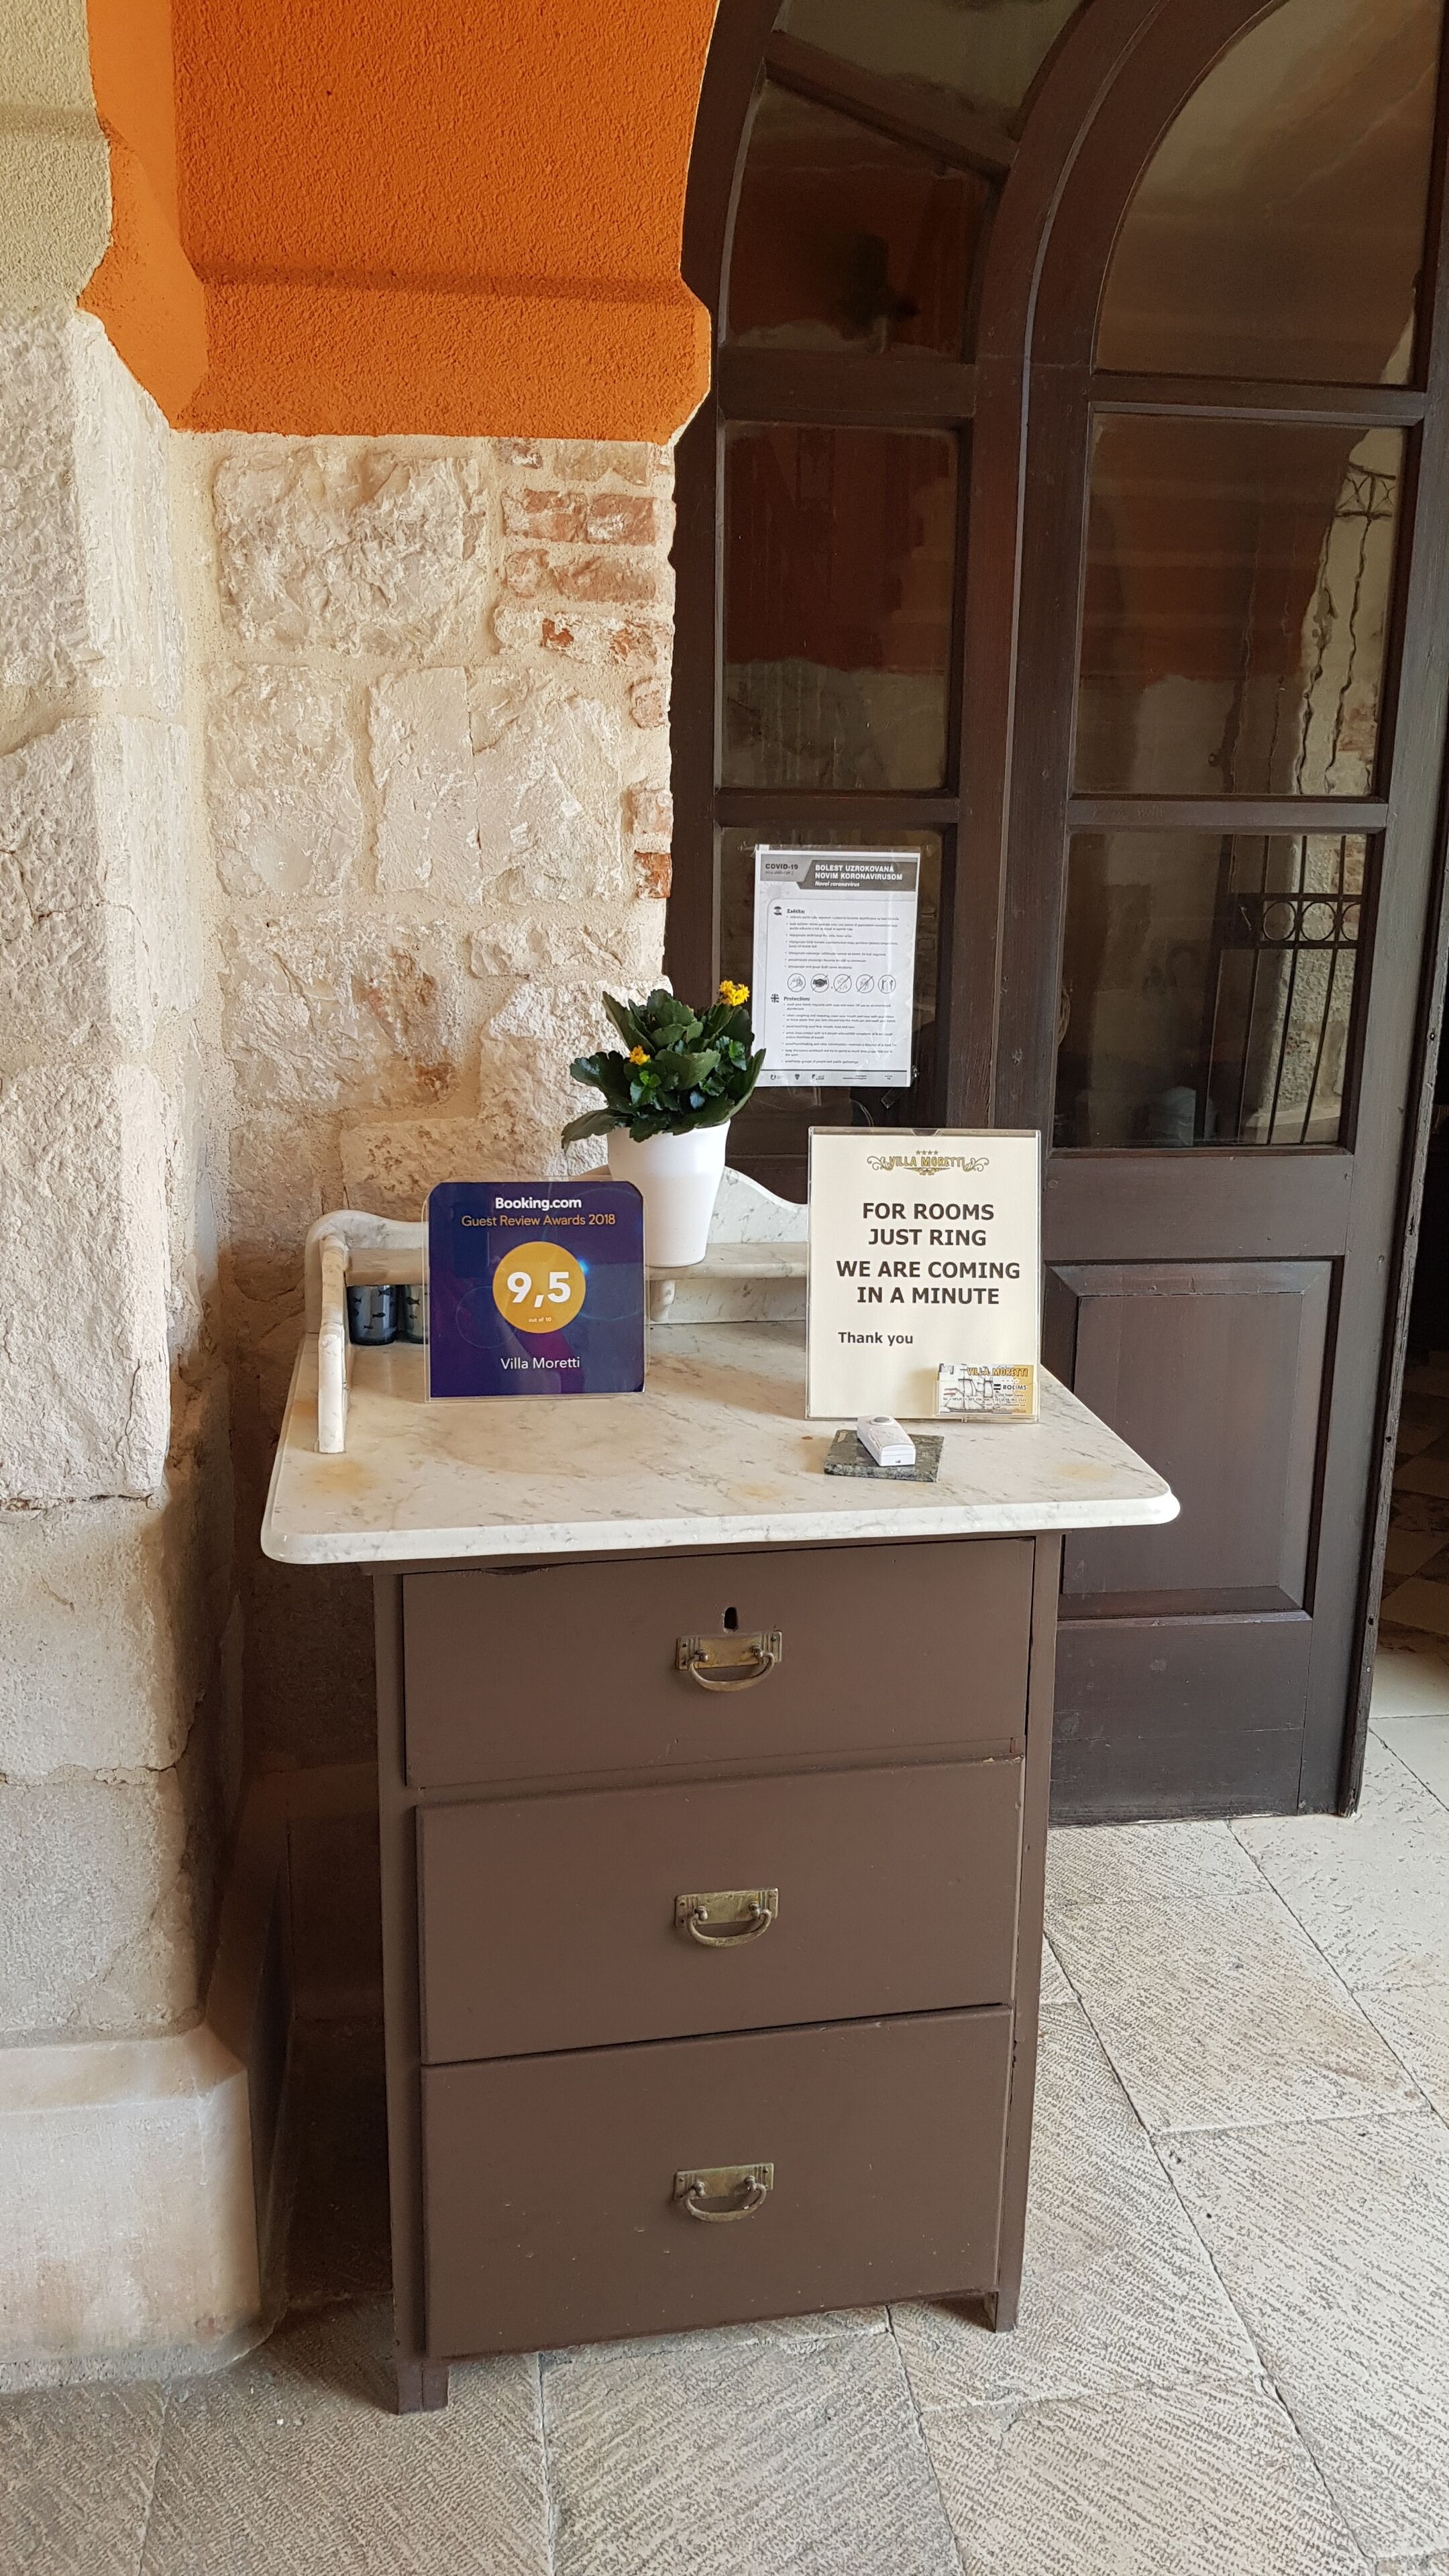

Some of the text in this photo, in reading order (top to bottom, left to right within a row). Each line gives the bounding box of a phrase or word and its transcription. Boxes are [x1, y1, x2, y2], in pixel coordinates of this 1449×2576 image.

[814, 871, 903, 881] NOVIM KORONAVIRUSOM
[815, 864, 895, 873] BOLEST UZROKOVANA
[889, 1156, 965, 1168] VILLA MORETTI
[495, 1196, 583, 1213] Booking.com
[863, 1202, 995, 1222] FOR ROOMS
[462, 1214, 616, 1227] Guest Review Awards 2018
[868, 1228, 987, 1247] JUST RING
[836, 1260, 1020, 1279] WE ARE COMING
[507, 1271, 571, 1308] 9,5
[857, 1287, 1000, 1305] IN A MINUTE
[838, 1331, 914, 1347] Thank you
[500, 1355, 581, 1370] Villa Moretti
[967, 1366, 1028, 1377] VILLA MORETTI
